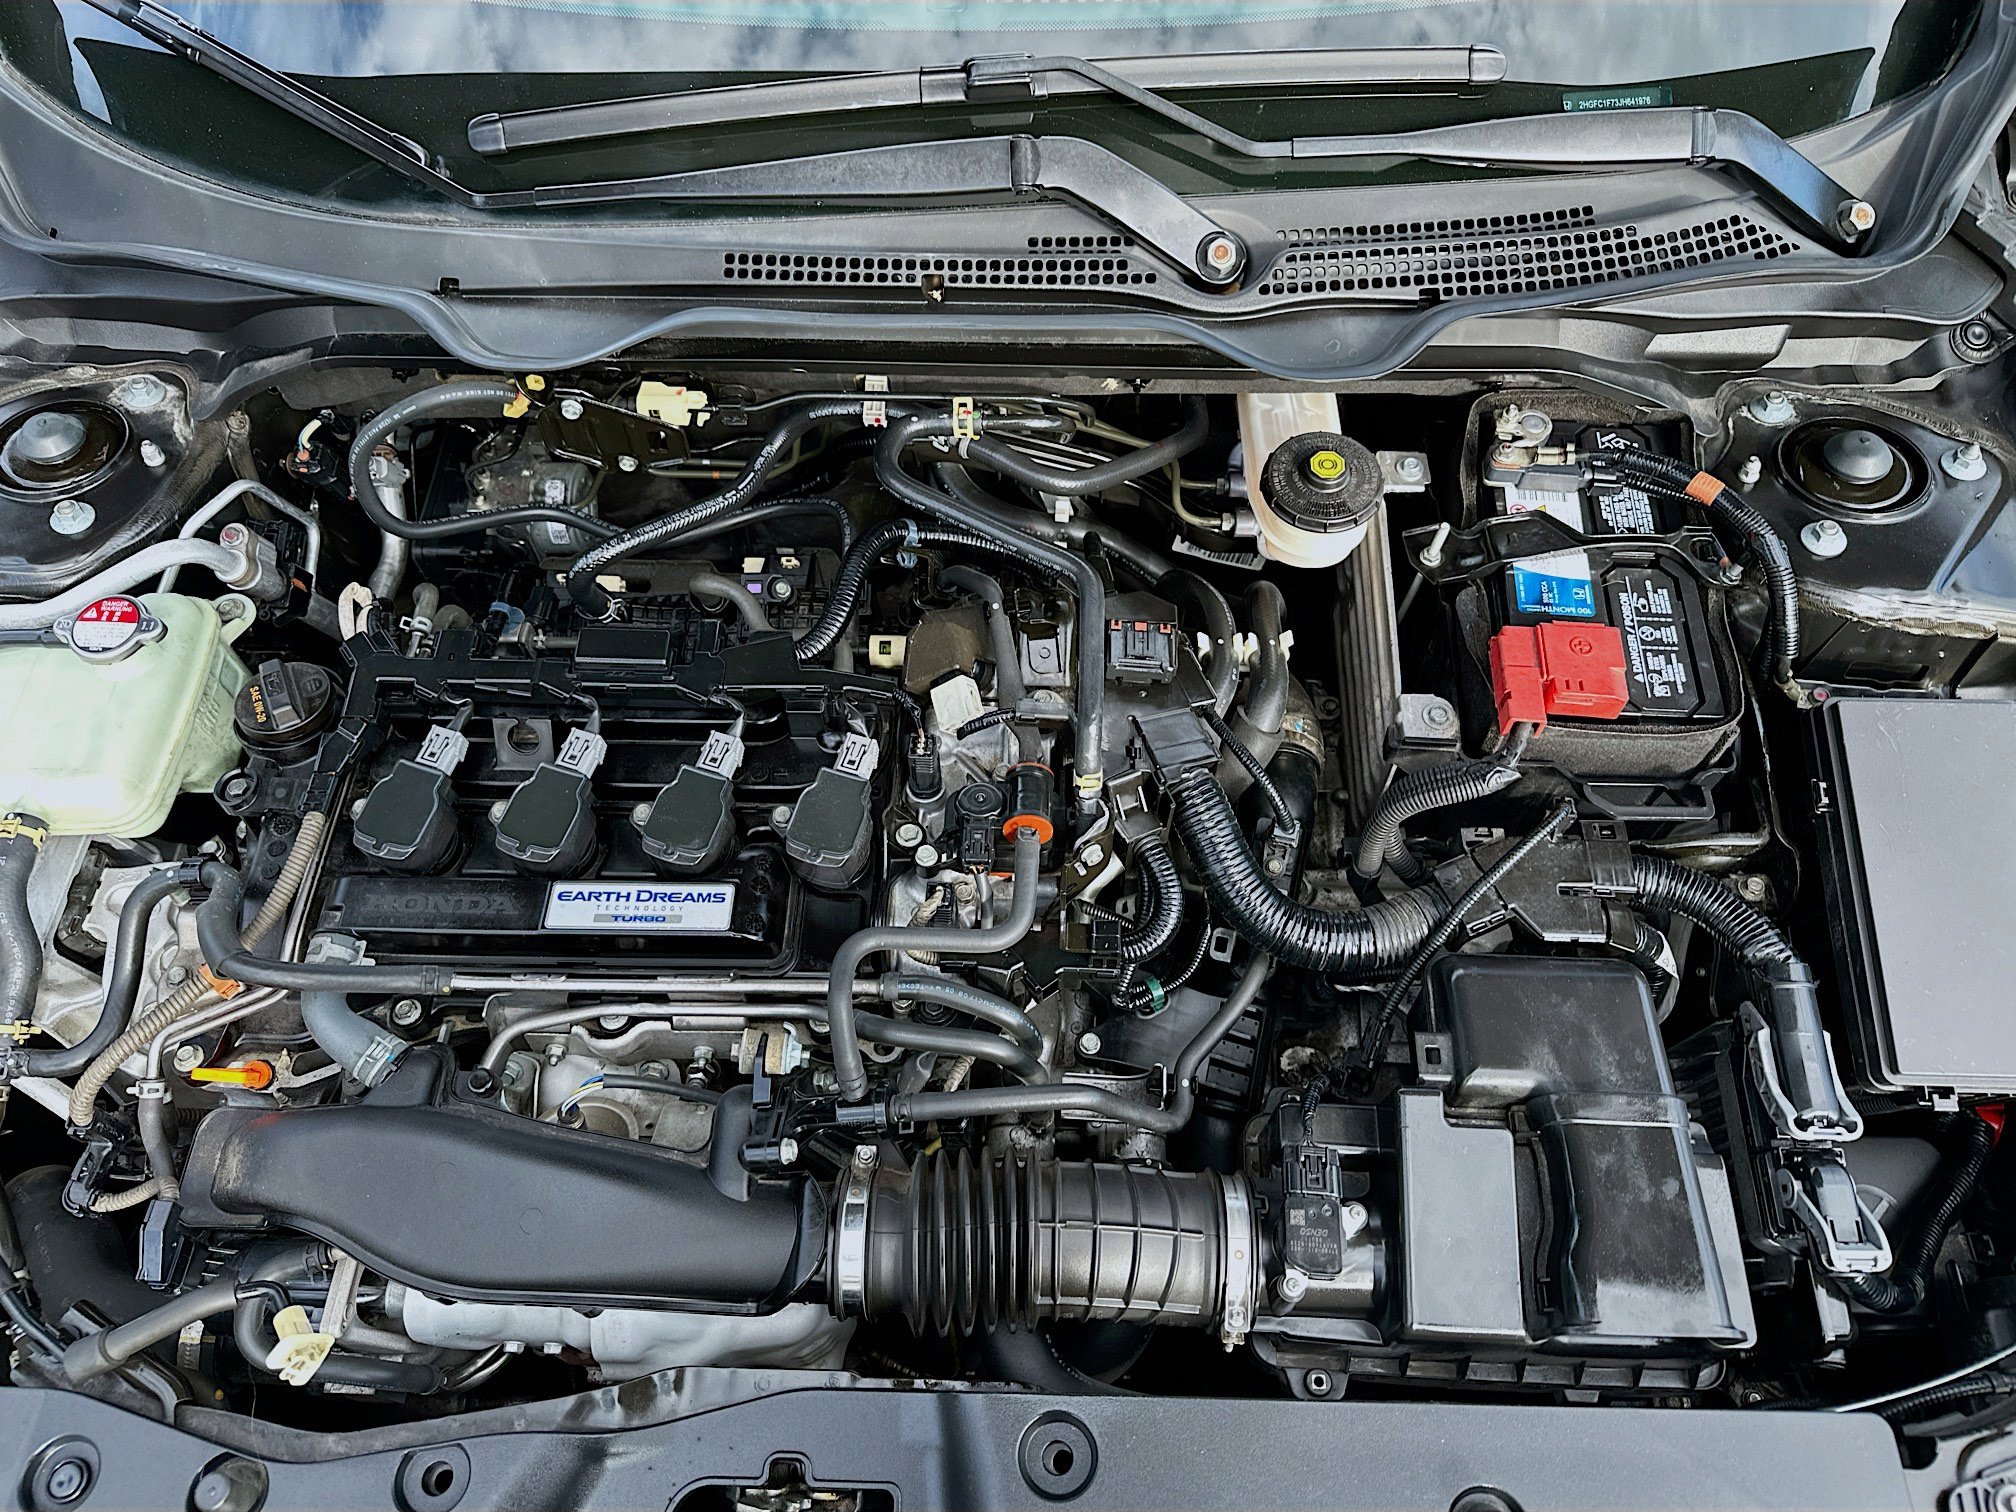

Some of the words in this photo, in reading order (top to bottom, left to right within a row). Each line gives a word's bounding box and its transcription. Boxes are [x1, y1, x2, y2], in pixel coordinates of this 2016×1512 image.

[1541, 605, 1576, 613] MONTH
[1577, 607, 1593, 615] 100
[1618, 592, 1634, 626] POISON
[1626, 634, 1643, 673] DANGER
[249, 685, 262, 703] SAE
[557, 890, 631, 903] EARTH
[636, 890, 726, 903] DREAMS
[362, 892, 521, 914] HONDA
[596, 904, 685, 912] TECHNOLOGY
[611, 915, 666, 923] TURBO
[1300, 1228, 1329, 1237] DENSO
